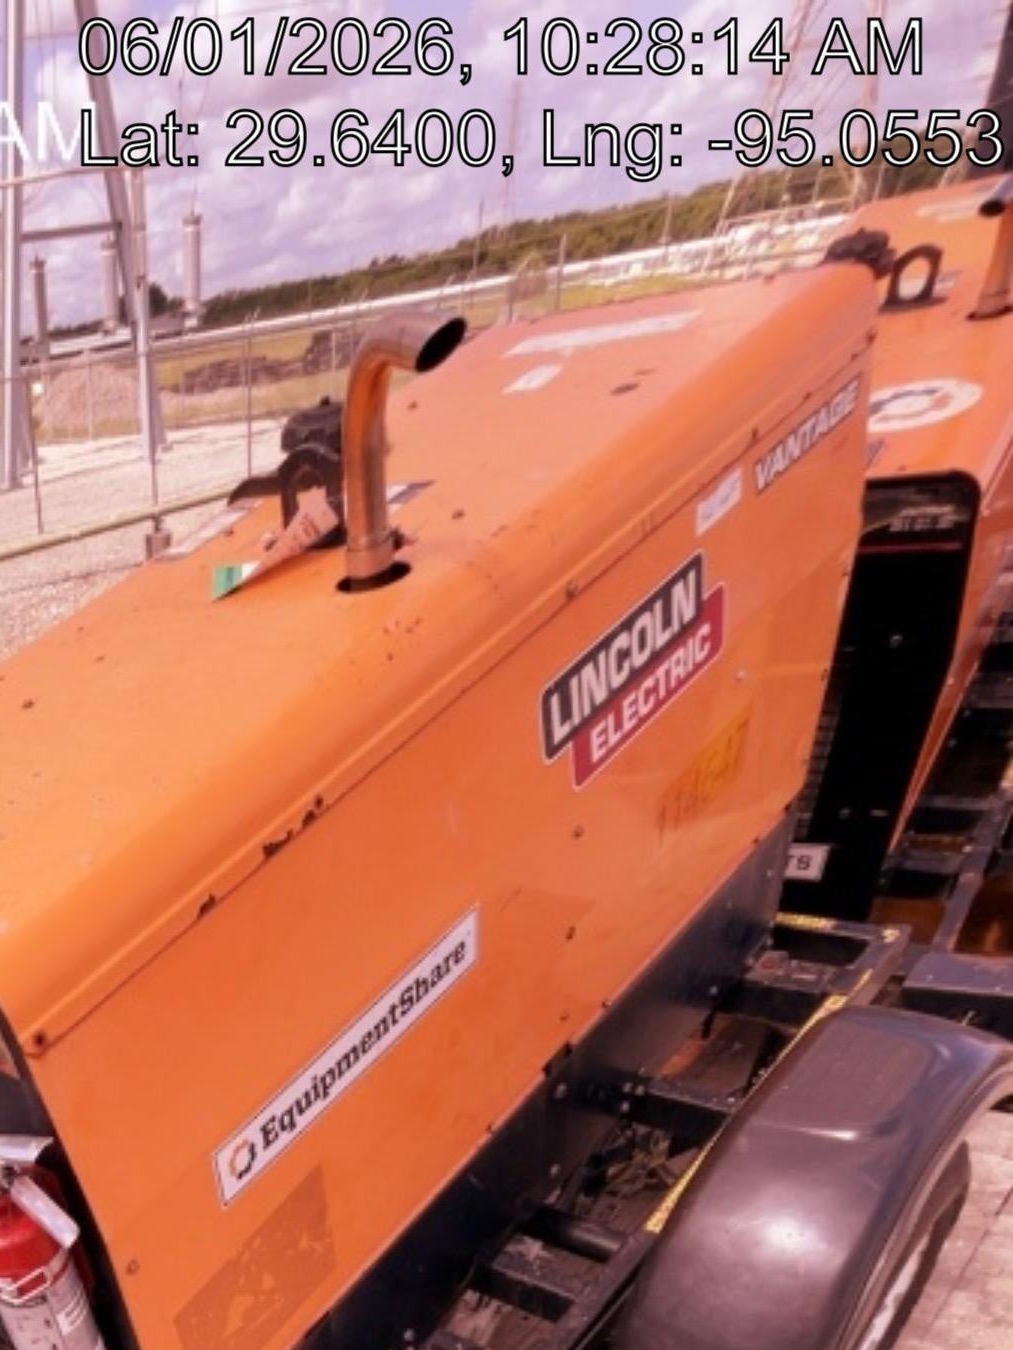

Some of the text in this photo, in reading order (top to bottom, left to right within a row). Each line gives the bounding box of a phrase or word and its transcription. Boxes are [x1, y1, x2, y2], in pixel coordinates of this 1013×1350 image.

[753, 378, 860, 493] VANTAGE
[549, 568, 697, 746] LINCOLN
[589, 622, 712, 764] ELECTRIC
[259, 938, 467, 1152] EquipmentShare
